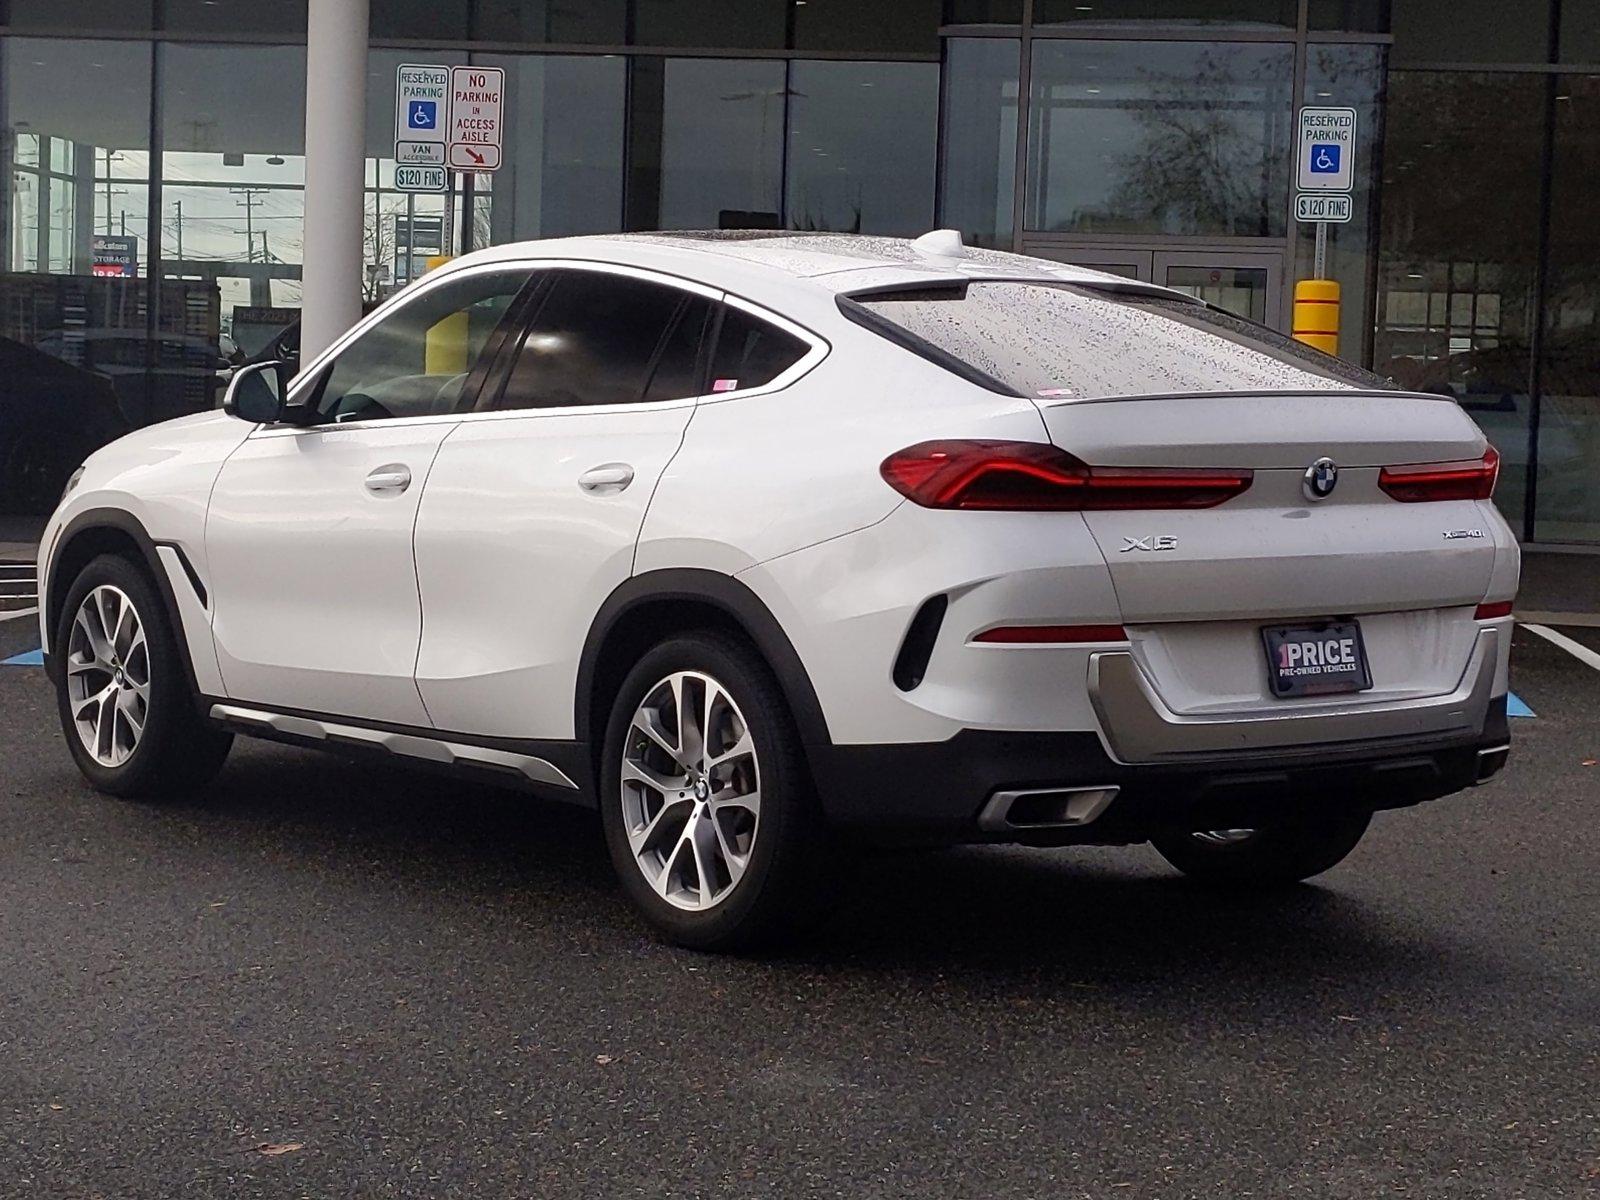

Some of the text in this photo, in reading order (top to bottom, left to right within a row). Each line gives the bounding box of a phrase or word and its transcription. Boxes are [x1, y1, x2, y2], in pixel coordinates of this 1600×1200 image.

[402, 73, 446, 85] RESERVED
[469, 75, 486, 88] NO
[404, 87, 443, 98] PARKING
[456, 92, 498, 103] PARKING
[472, 106, 480, 115] IN
[457, 119, 495, 130] ACCESS
[1304, 116, 1351, 126] RESERVED
[462, 132, 489, 143] AISLE
[1306, 130, 1348, 141] PARKING
[412, 145, 431, 154] VAN
[398, 171, 443, 185] $120 FINE
[1328, 201, 1347, 216] FINE
[1120, 535, 1178, 552] X6
[1280, 663, 1357, 677] PRE-OWNED VEHICLES
